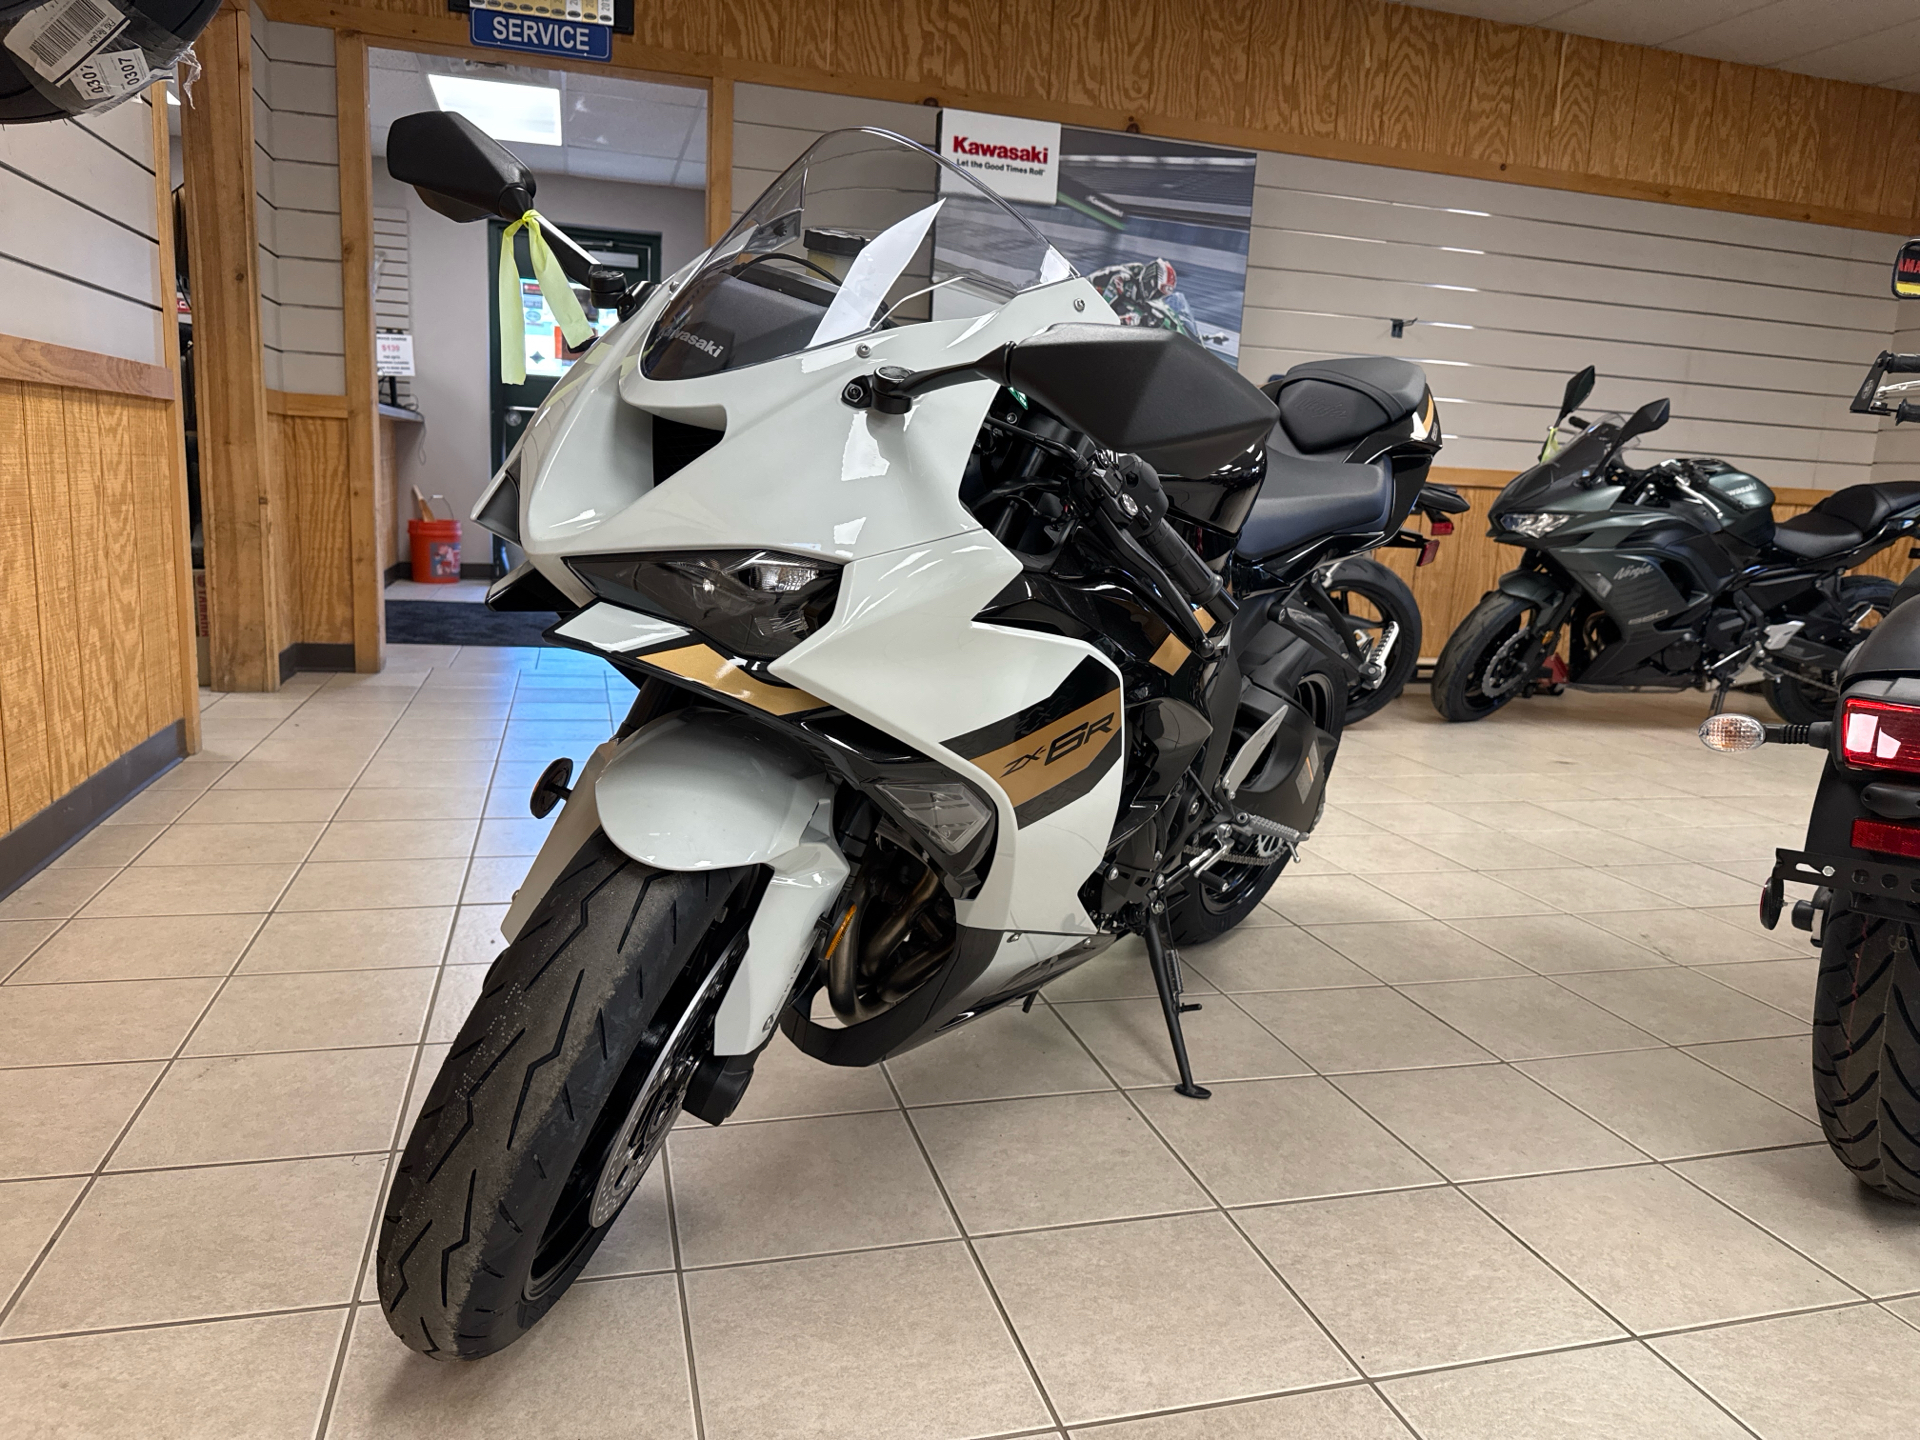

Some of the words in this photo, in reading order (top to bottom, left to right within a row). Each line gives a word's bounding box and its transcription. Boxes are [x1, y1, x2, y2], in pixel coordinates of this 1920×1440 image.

[492, 16, 590, 51] SERVICE
[117, 58, 140, 86] 0307
[953, 135, 1049, 164] Kawasaki
[957, 159, 969, 167] Let
[970, 160, 983, 169] the
[984, 162, 1005, 171] Good
[1005, 164, 1028, 174] Times
[1613, 562, 1654, 580] Ninja
